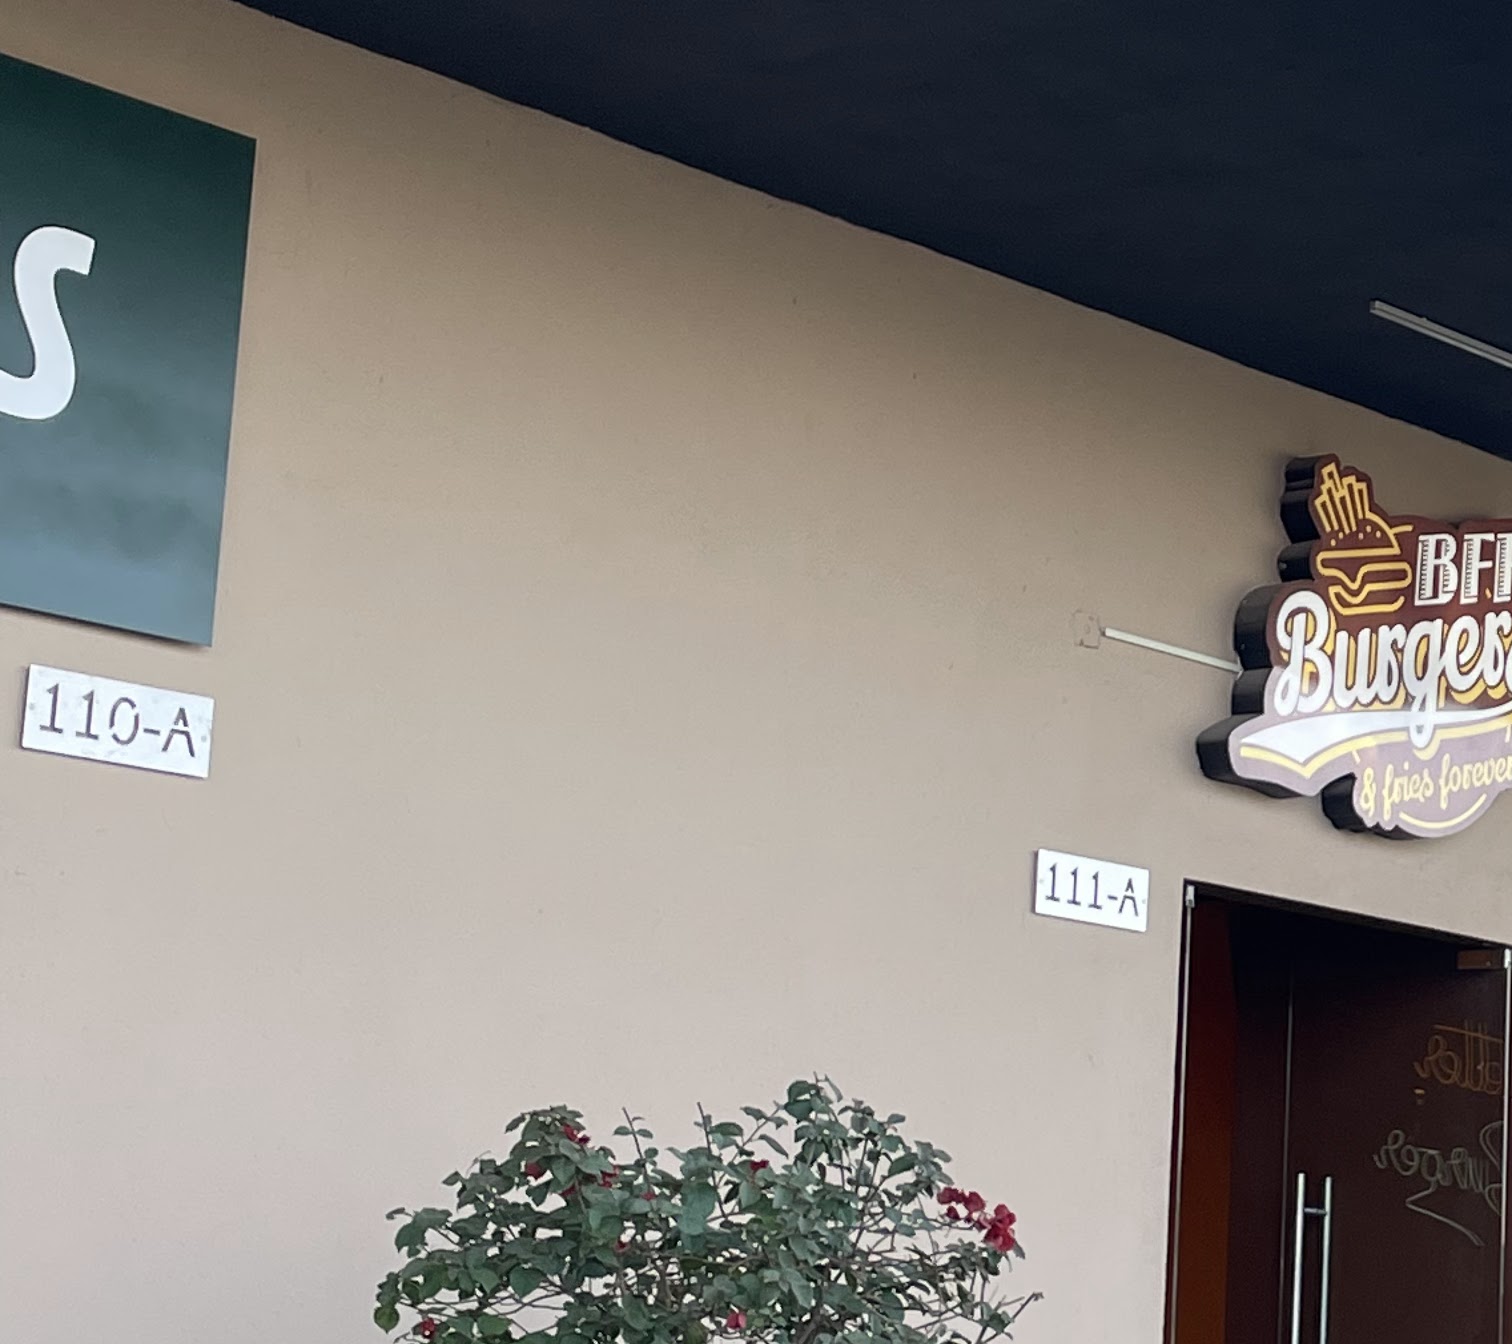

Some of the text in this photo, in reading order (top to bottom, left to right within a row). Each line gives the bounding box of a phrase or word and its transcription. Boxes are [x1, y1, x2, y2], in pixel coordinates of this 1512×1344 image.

[39, 683, 196, 758] 110-A
[1359, 767, 1377, 818] &
[1382, 763, 1434, 822] fries
[1045, 862, 1139, 917] 111-A
